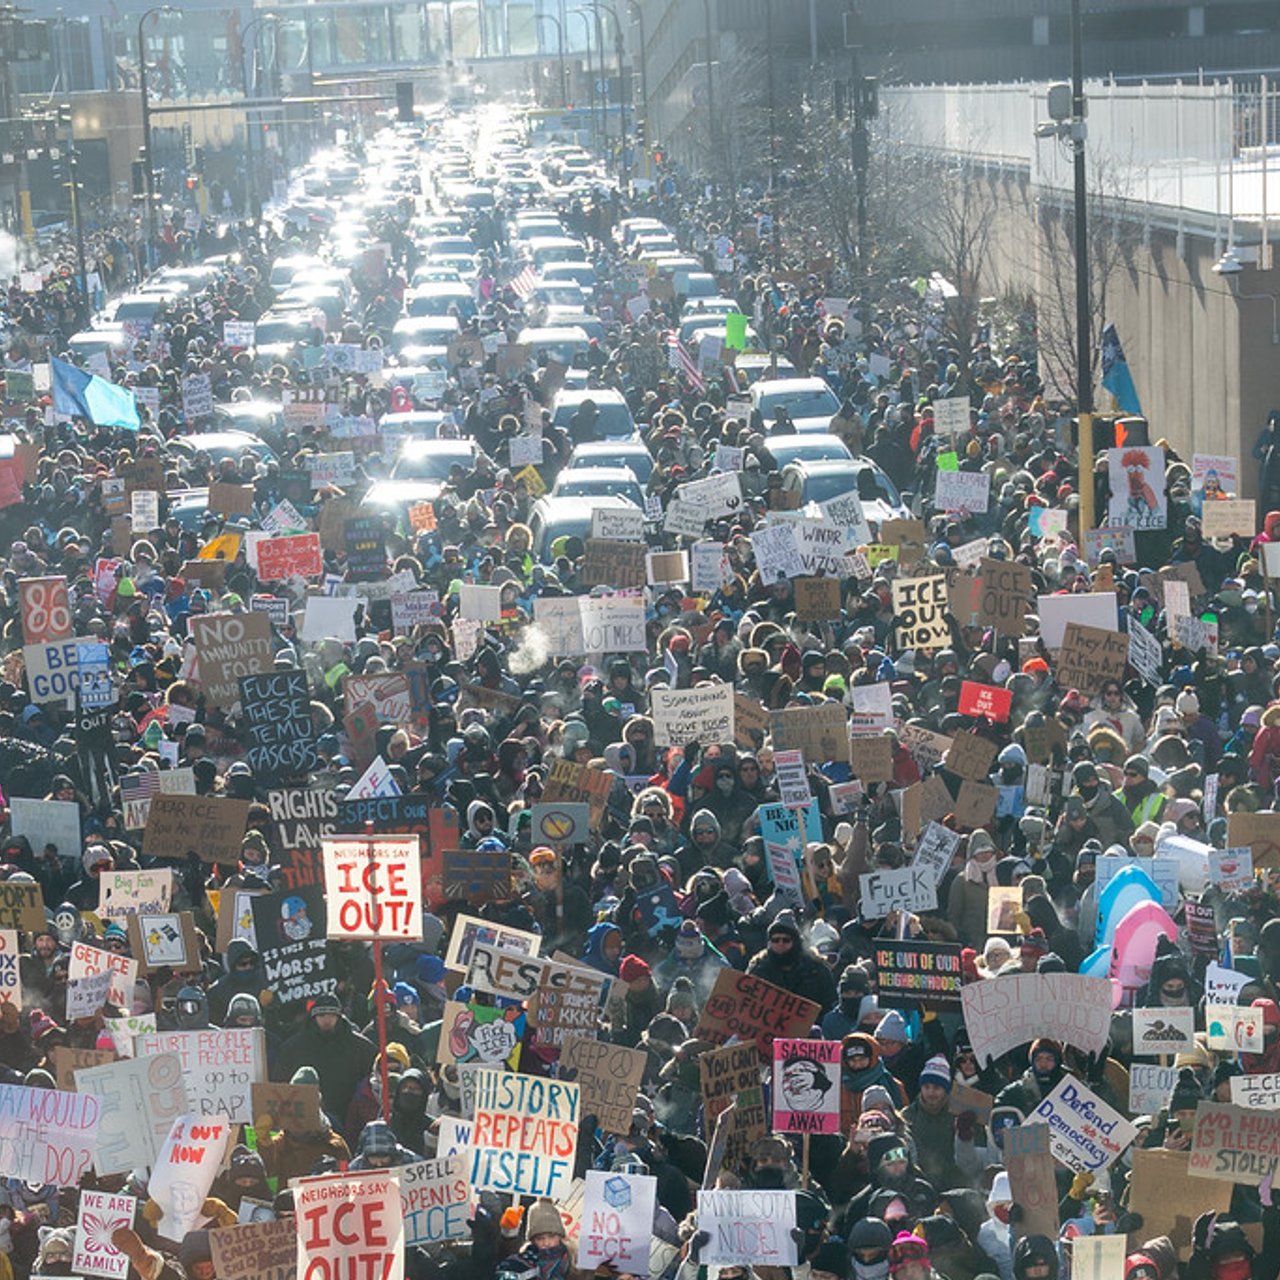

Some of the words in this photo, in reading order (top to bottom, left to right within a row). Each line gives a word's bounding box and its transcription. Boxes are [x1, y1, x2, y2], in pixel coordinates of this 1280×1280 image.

[900, 581, 948, 604] ICE
[900, 606, 948, 628] OUT
[901, 626, 950, 649] NOW
[244, 677, 304, 701] FUCK
[245, 700, 304, 721] THESE
[250, 719, 311, 741] TEMU
[249, 737, 319, 770] FASCISTS
[338, 866, 408, 896] ICE
[340, 901, 414, 934] OUT!
[876, 950, 895, 968] ICE
[896, 952, 918, 970] OUT
[921, 953, 934, 970] OF
[936, 954, 960, 972] OUR
[781, 1041, 834, 1059] SASHAY
[479, 1072, 579, 1121] HISTORY
[1059, 1082, 1113, 1133] Defend
[787, 1114, 827, 1131] AWAY
[1037, 1099, 1110, 1168] Democracy
[475, 1113, 576, 1156] REPEATS
[472, 1150, 568, 1195] ITSELF
[83, 1195, 103, 1207] WE
[106, 1197, 133, 1213] ARE
[75, 1252, 125, 1275] FAMILY
